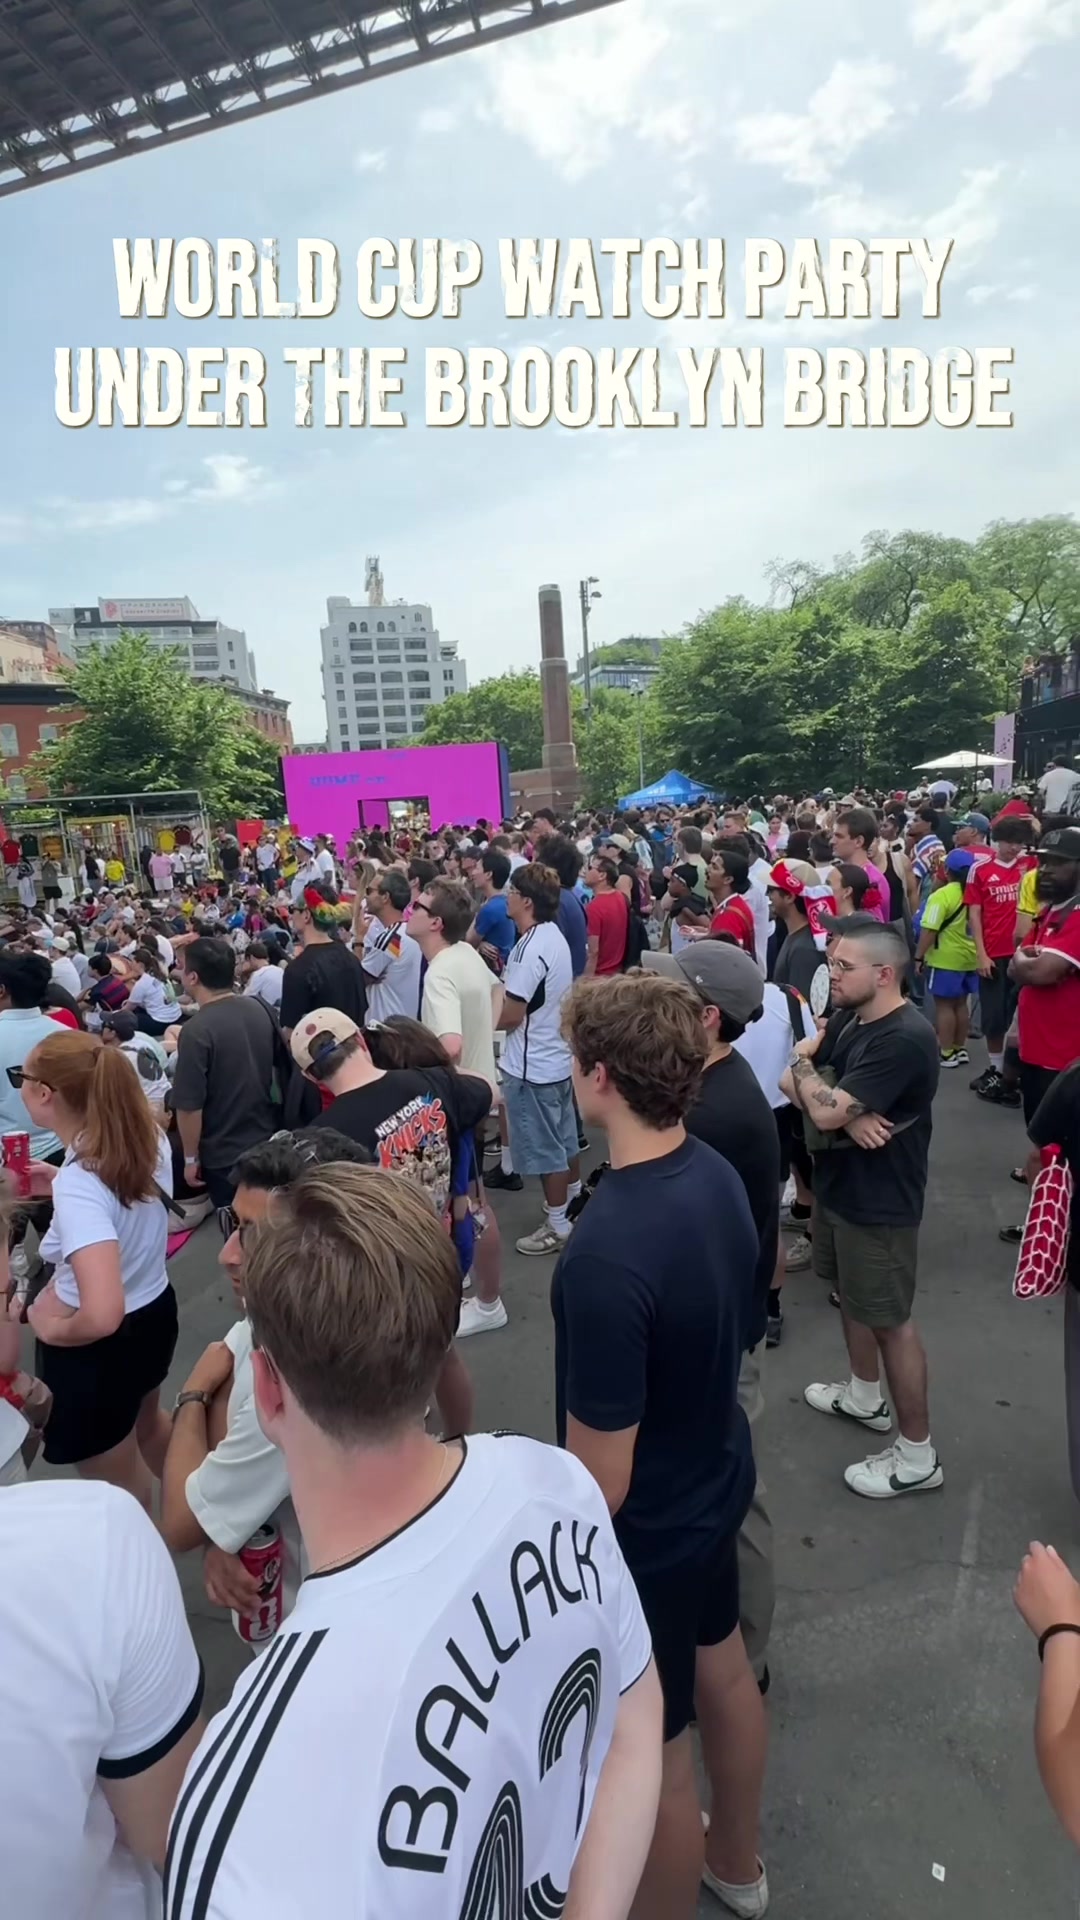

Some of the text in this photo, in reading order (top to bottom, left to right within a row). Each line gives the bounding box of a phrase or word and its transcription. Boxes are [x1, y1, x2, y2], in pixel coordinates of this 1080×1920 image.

[374, 1095, 426, 1138] NEW YORK
[377, 1098, 446, 1169] KNICKS
[377, 1519, 603, 1874] BALLACK
